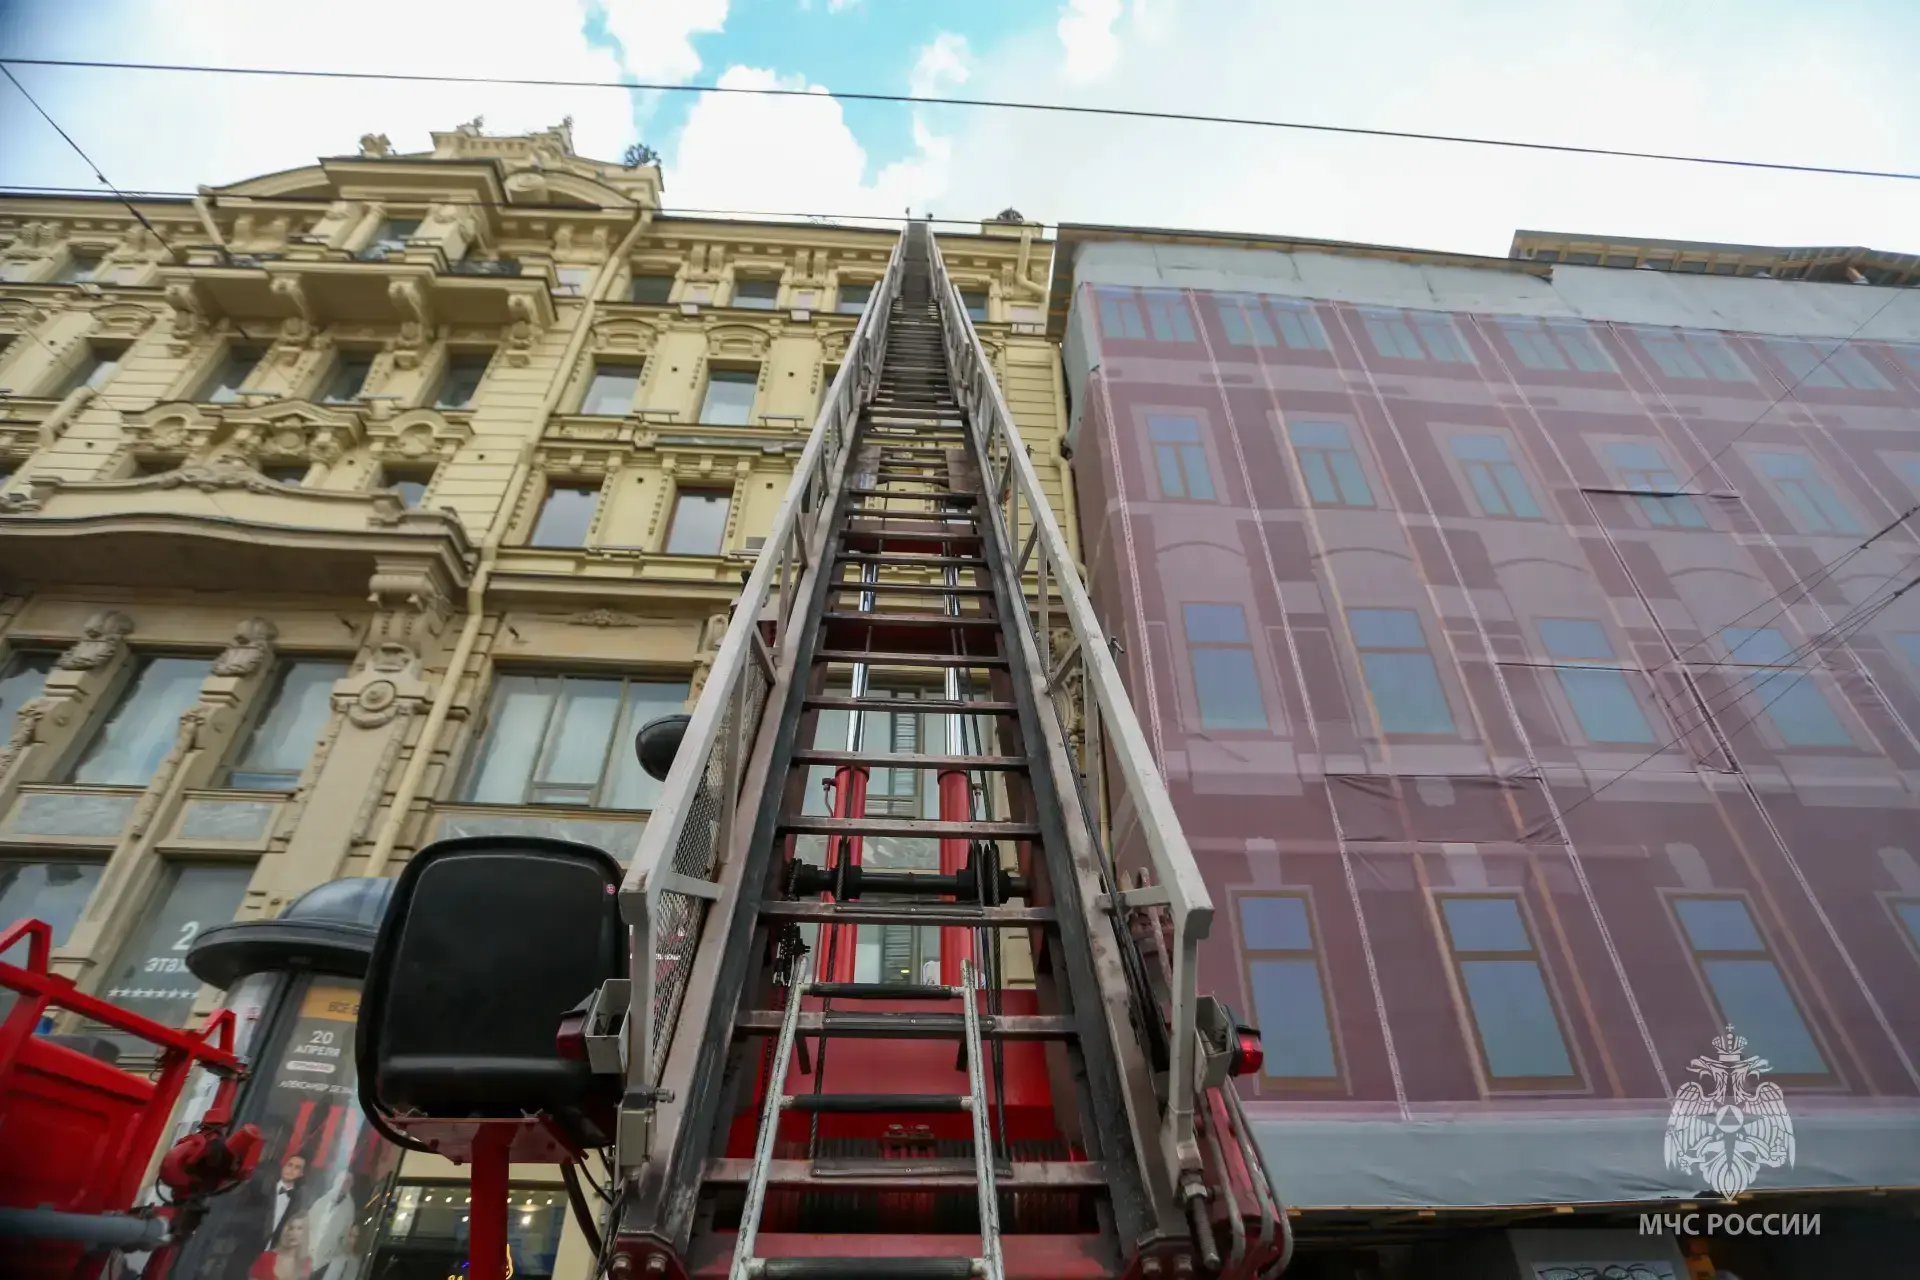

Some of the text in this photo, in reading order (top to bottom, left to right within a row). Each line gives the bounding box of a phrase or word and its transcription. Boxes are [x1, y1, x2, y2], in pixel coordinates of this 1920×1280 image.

[171, 921, 200, 950] 2
[309, 1030, 334, 1044] 20
[293, 1044, 340, 1057] АПРЕЛЯ
